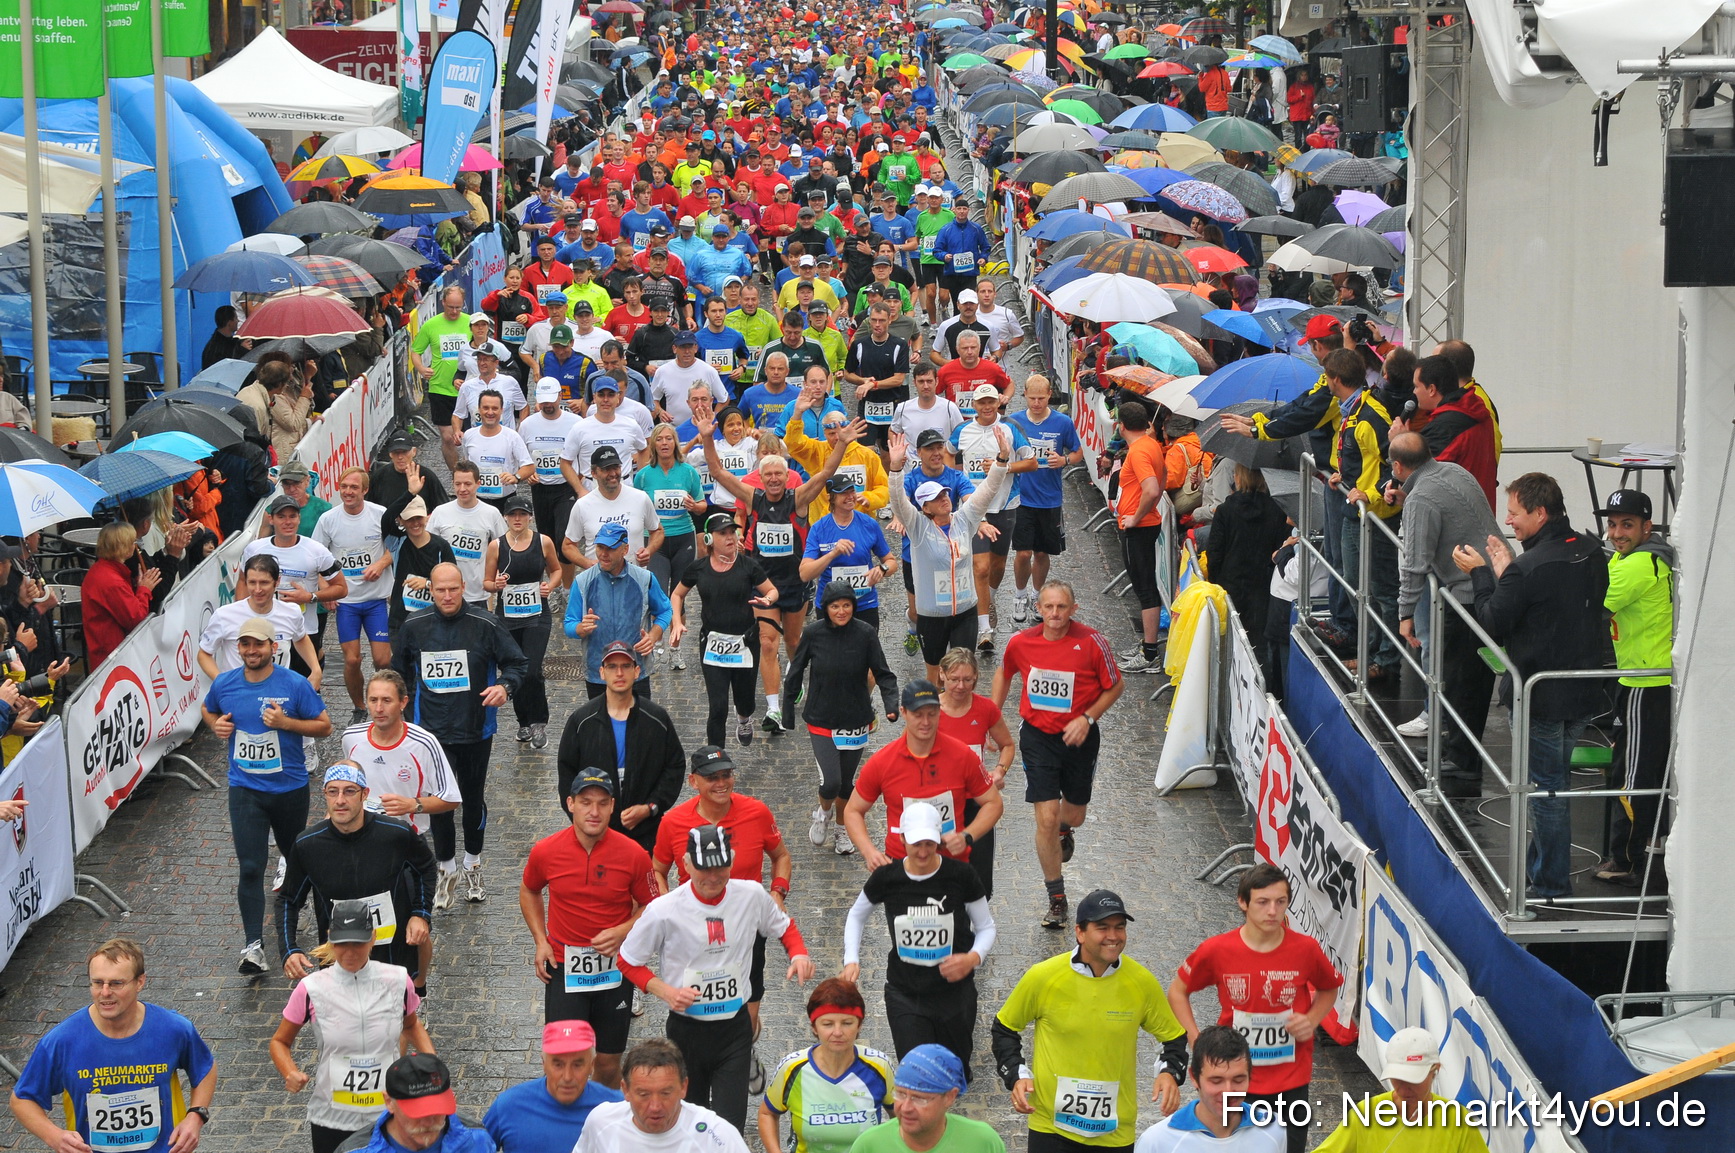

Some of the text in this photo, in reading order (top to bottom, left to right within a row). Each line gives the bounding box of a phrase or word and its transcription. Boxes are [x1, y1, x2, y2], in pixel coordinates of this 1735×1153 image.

[57, 16, 88, 27] leben.
[543, 9, 562, 103] Audi BKK
[446, 63, 481, 84] maxi
[463, 93, 477, 108] dsl
[248, 111, 345, 122] www.audibkk.de
[955, 256, 973, 266] 2625
[503, 326, 526, 338] 2664
[867, 405, 891, 416] 3215
[599, 513, 625, 523] Lauf
[451, 533, 482, 550] 2653
[759, 531, 790, 545] 2619
[341, 553, 372, 569] 2649
[506, 591, 538, 606] 2861
[710, 639, 741, 655] 2622
[426, 661, 465, 678] 2572
[431, 680, 461, 688] Wolfgang
[1031, 679, 1069, 698] 3393
[239, 743, 276, 760] 3075
[901, 928, 949, 948] 3220
[570, 955, 616, 974] 2617
[577, 974, 610, 984] Christian
[703, 1004, 725, 1014] Horst
[1238, 1027, 1290, 1046] 2709
[1250, 1049, 1283, 1059] ohannes
[77, 1063, 168, 1079] 10. NEUMARKTER
[92, 1074, 155, 1088] STADTLAUF
[343, 1068, 382, 1092] 427
[351, 1095, 375, 1105] Linda
[1062, 1093, 1111, 1118] 2575
[811, 1103, 846, 1113] TEAM
[95, 1104, 154, 1131] 2535
[809, 1111, 867, 1126] BOCK
[1065, 1114, 1107, 1132] Ferdinand
[106, 1132, 144, 1144] Michael
